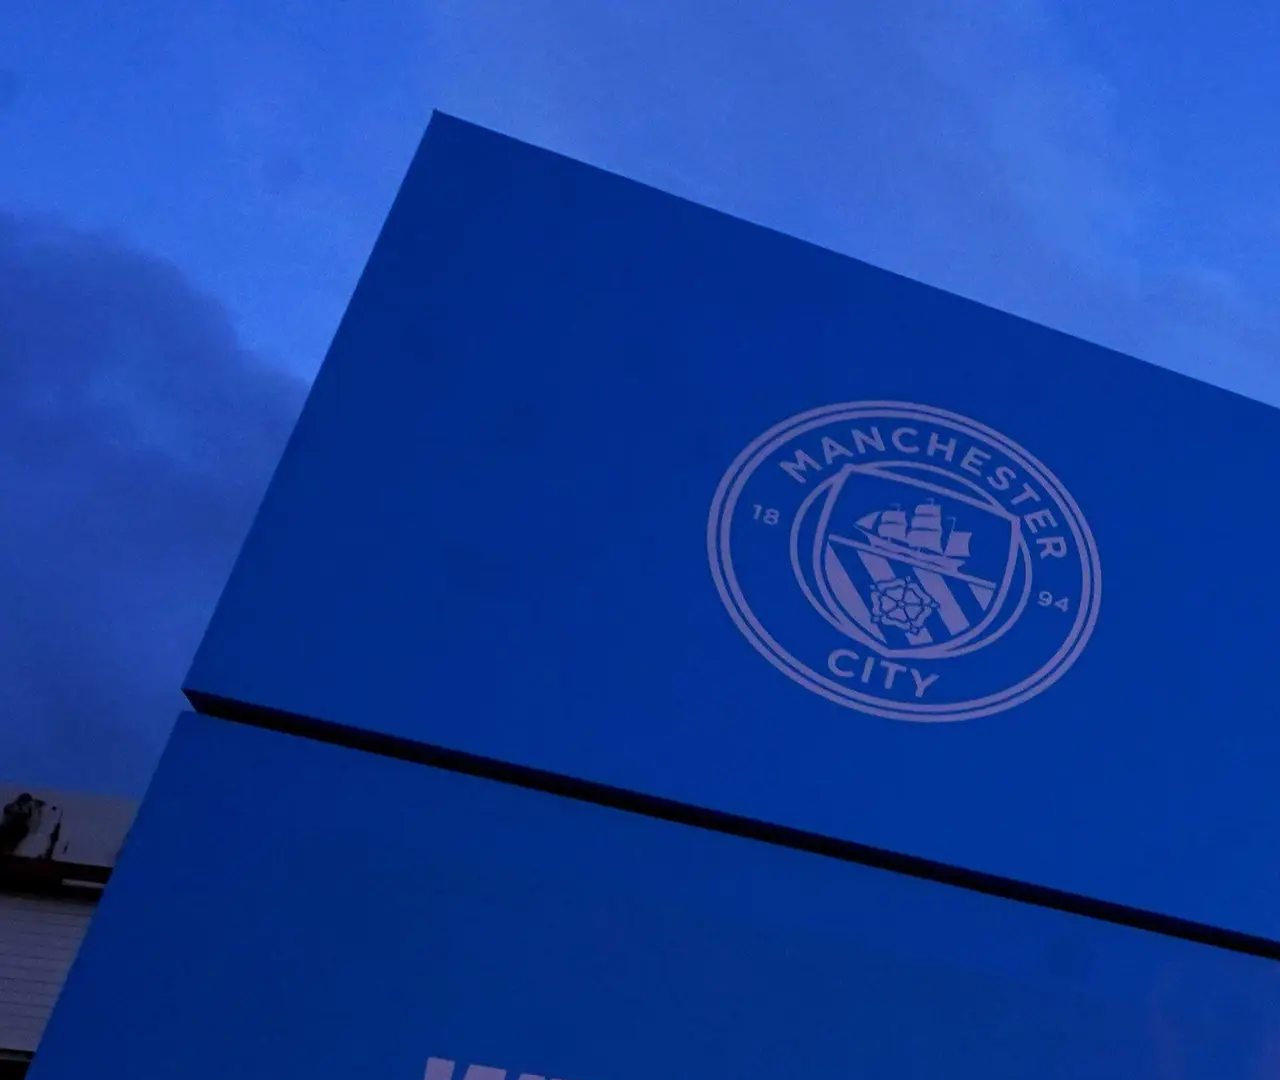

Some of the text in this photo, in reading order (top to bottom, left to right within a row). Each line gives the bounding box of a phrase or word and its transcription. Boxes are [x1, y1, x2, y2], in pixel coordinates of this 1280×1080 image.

[779, 426, 1068, 561] MANCHESTER
[752, 503, 780, 527] 18
[1037, 590, 1070, 613] 94
[826, 647, 940, 699] CITY
